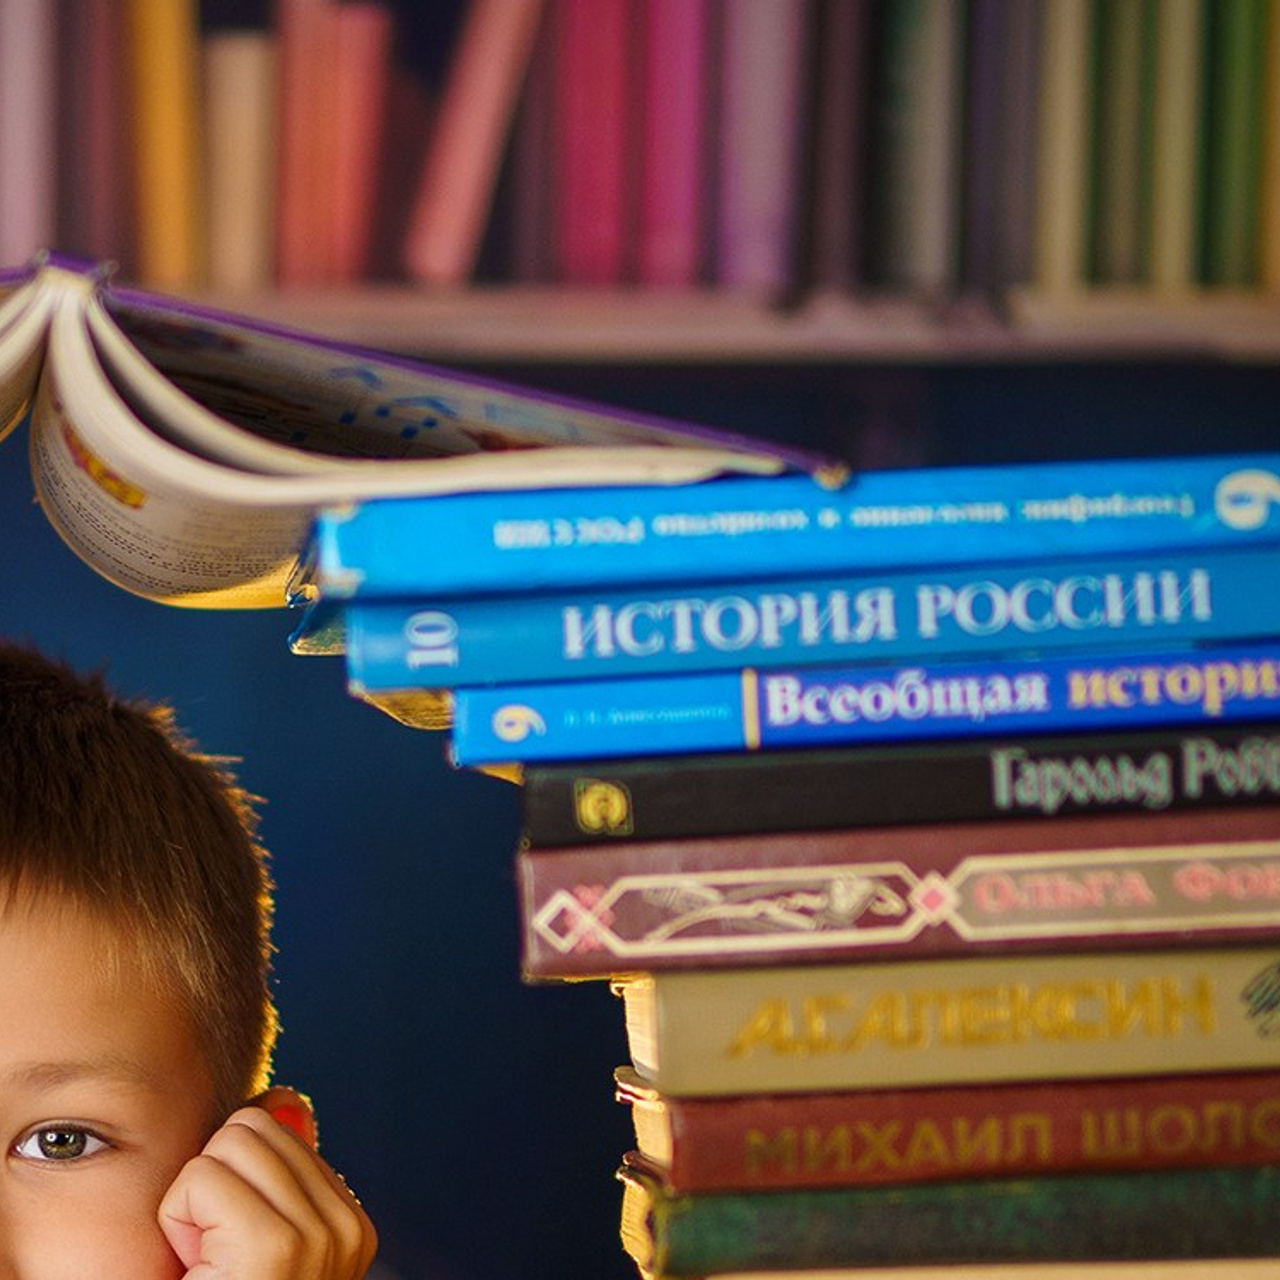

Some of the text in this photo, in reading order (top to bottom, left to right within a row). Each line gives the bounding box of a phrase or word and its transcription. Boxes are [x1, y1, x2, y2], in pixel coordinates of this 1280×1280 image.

[405, 611, 458, 669] 10
[563, 568, 1212, 659] ИСТОРИЯ РОССИИ
[766, 666, 1047, 727] Всеобщая
[990, 748, 1170, 815] Гарольд
[744, 1113, 1053, 1177] МИХАИЛ
